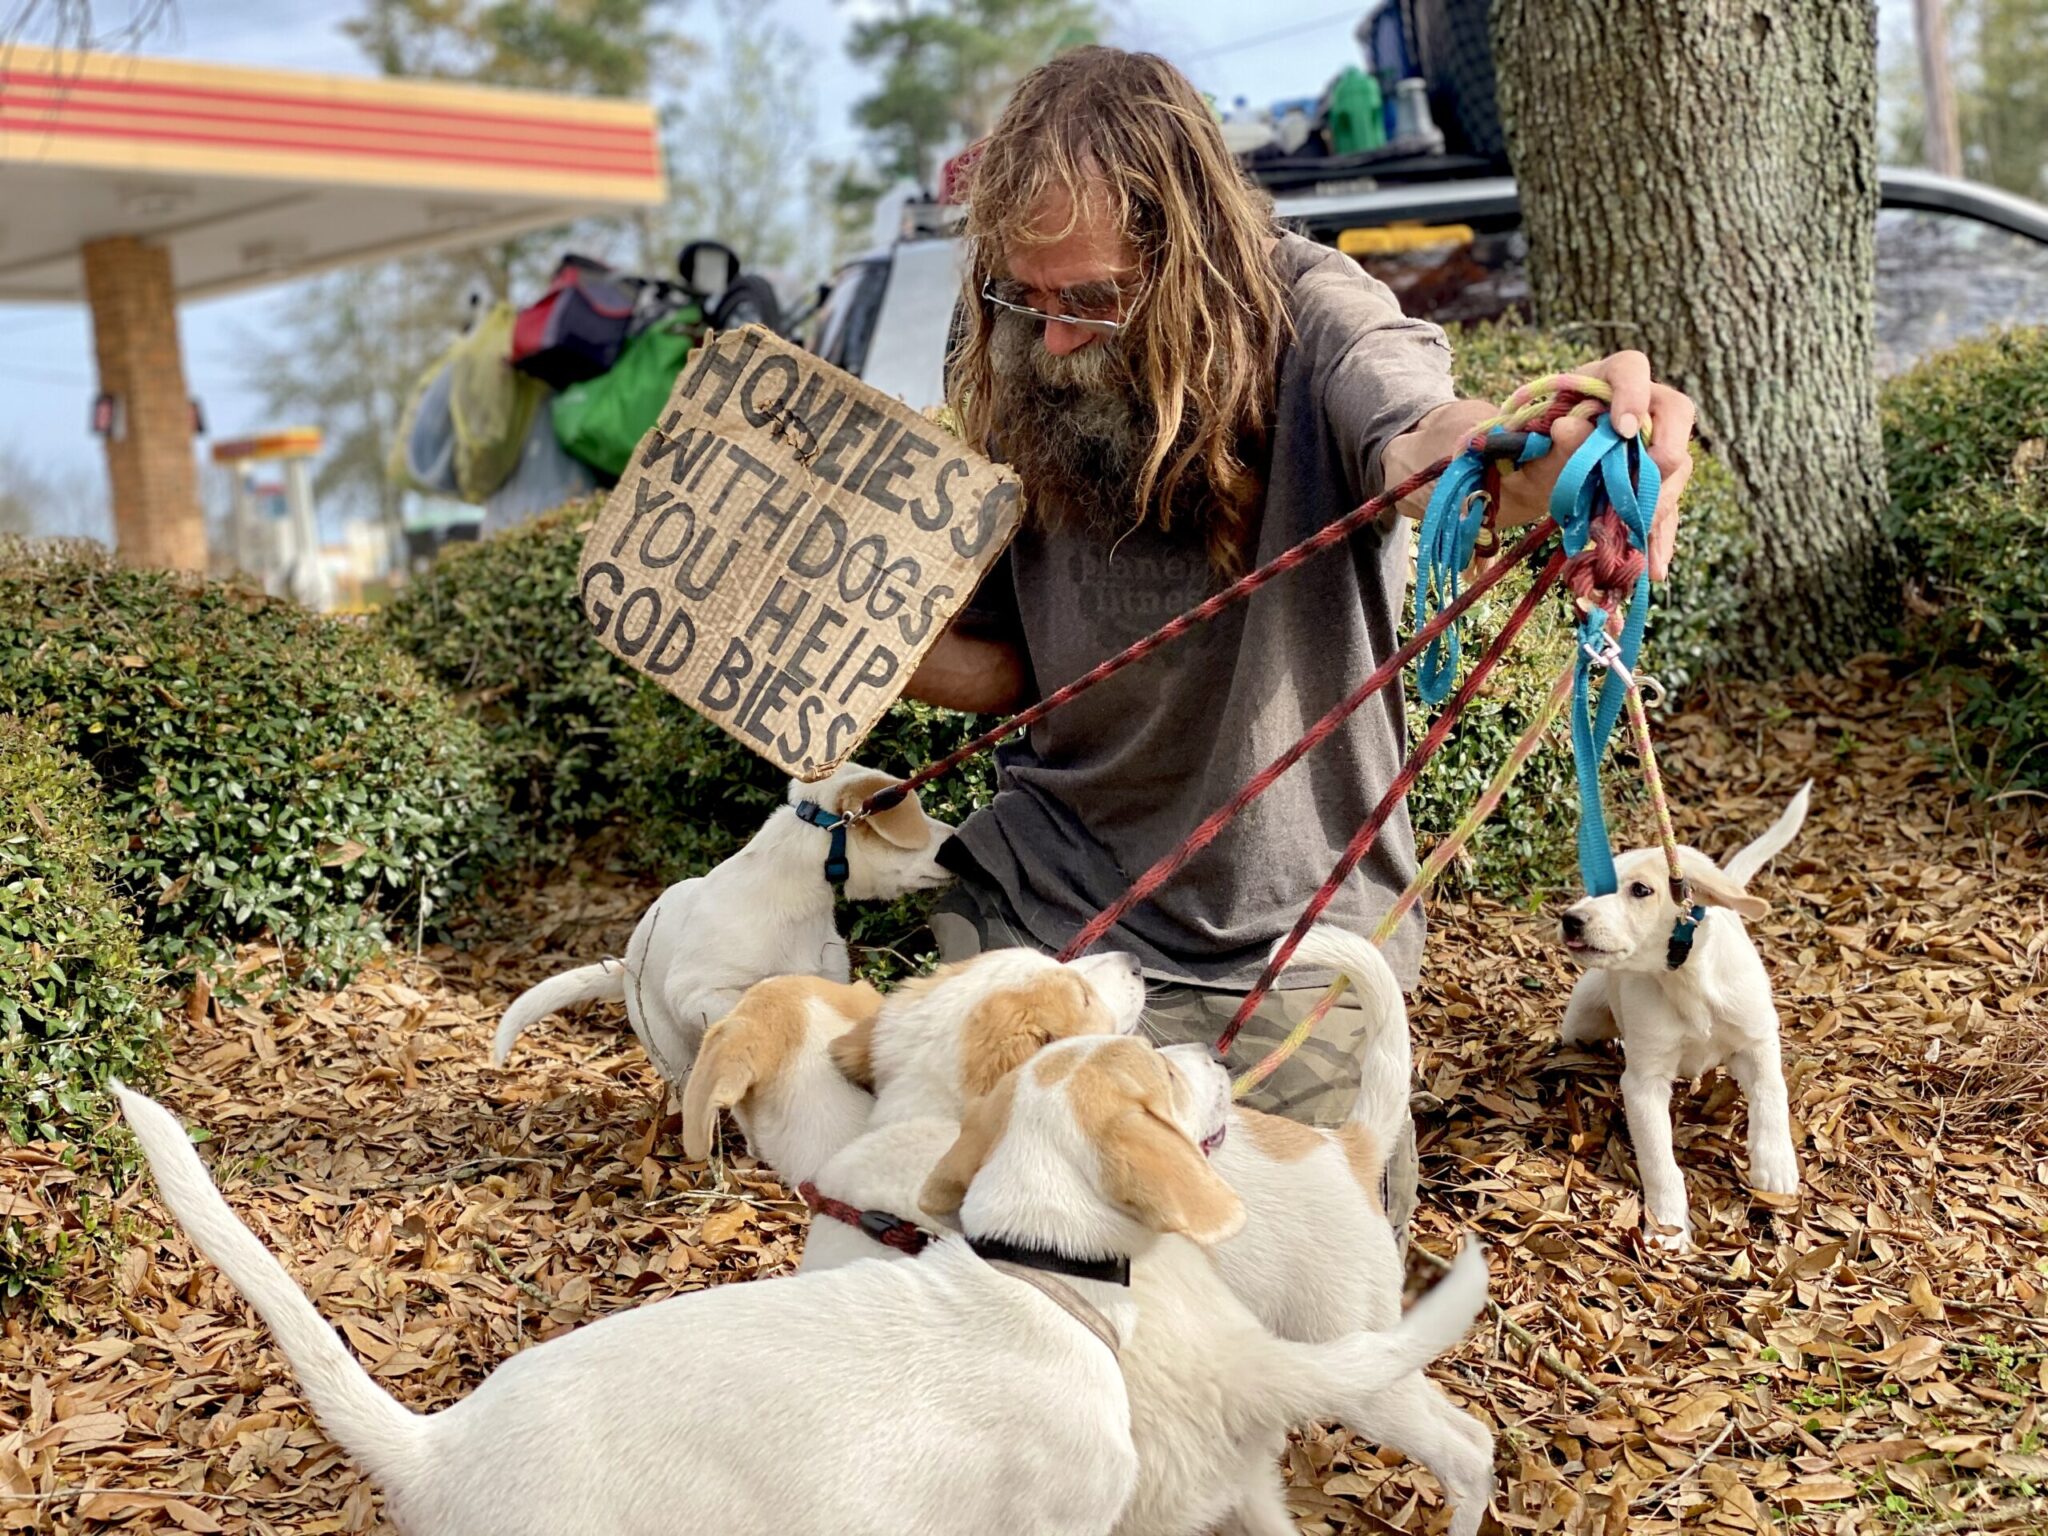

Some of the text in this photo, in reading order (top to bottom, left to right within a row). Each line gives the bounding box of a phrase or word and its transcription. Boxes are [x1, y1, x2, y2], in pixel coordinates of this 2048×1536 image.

[611, 477, 741, 601] YOU
[640, 410, 955, 647] WITH DOGS
[582, 563, 694, 675] GOD
